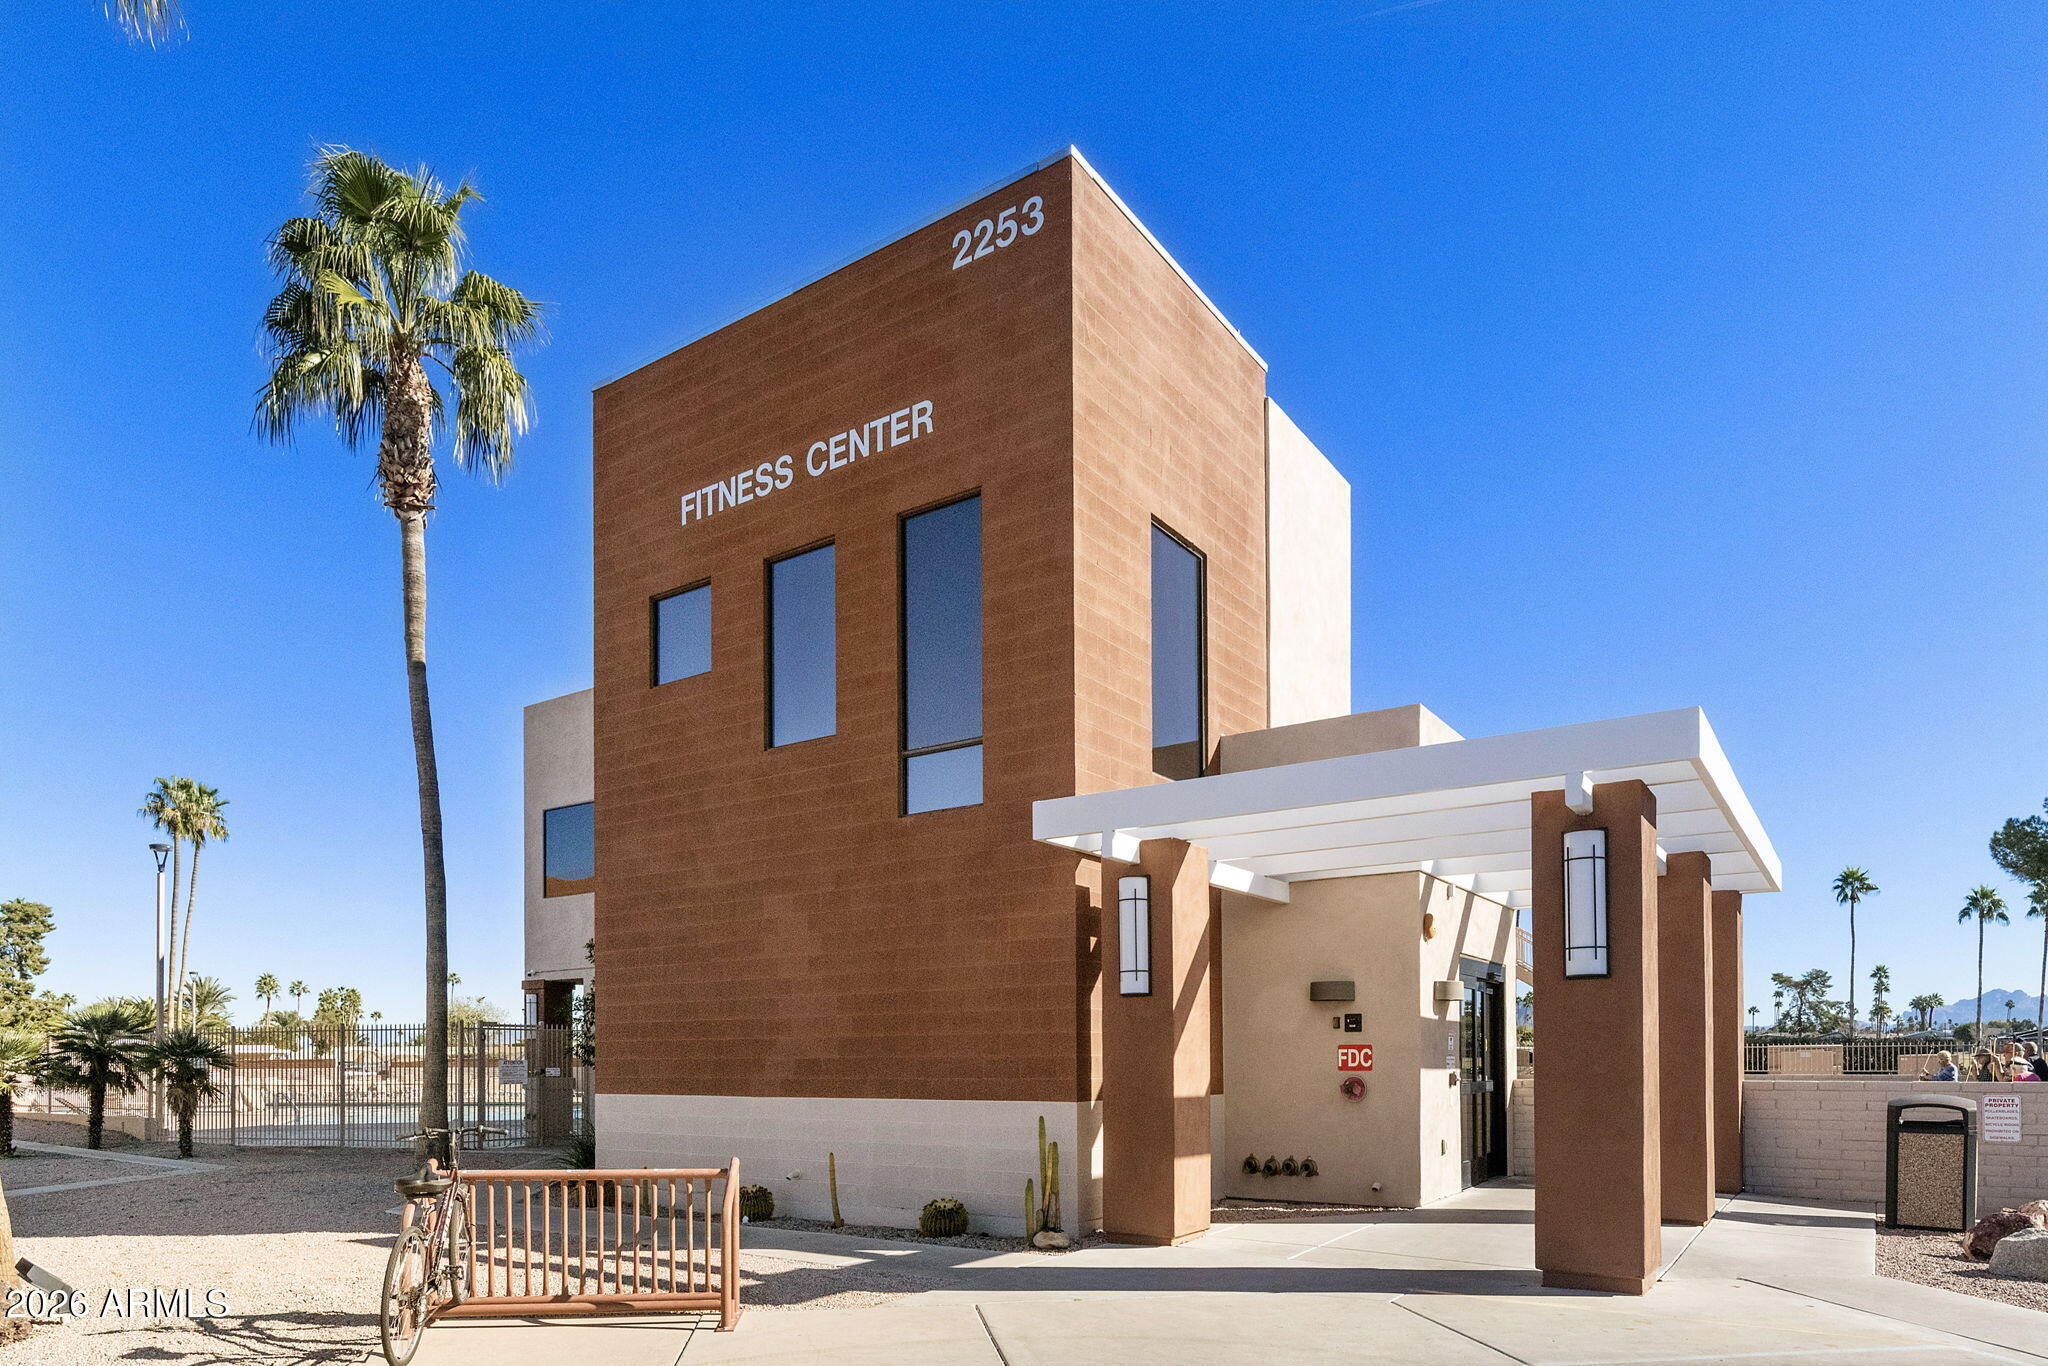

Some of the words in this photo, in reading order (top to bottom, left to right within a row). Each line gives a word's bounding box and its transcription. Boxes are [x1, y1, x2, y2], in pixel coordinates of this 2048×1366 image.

[952, 195, 1045, 270] 2253
[681, 454, 794, 526] FITNESS
[806, 399, 934, 477] CENTER
[1338, 1049, 1372, 1067] FDC
